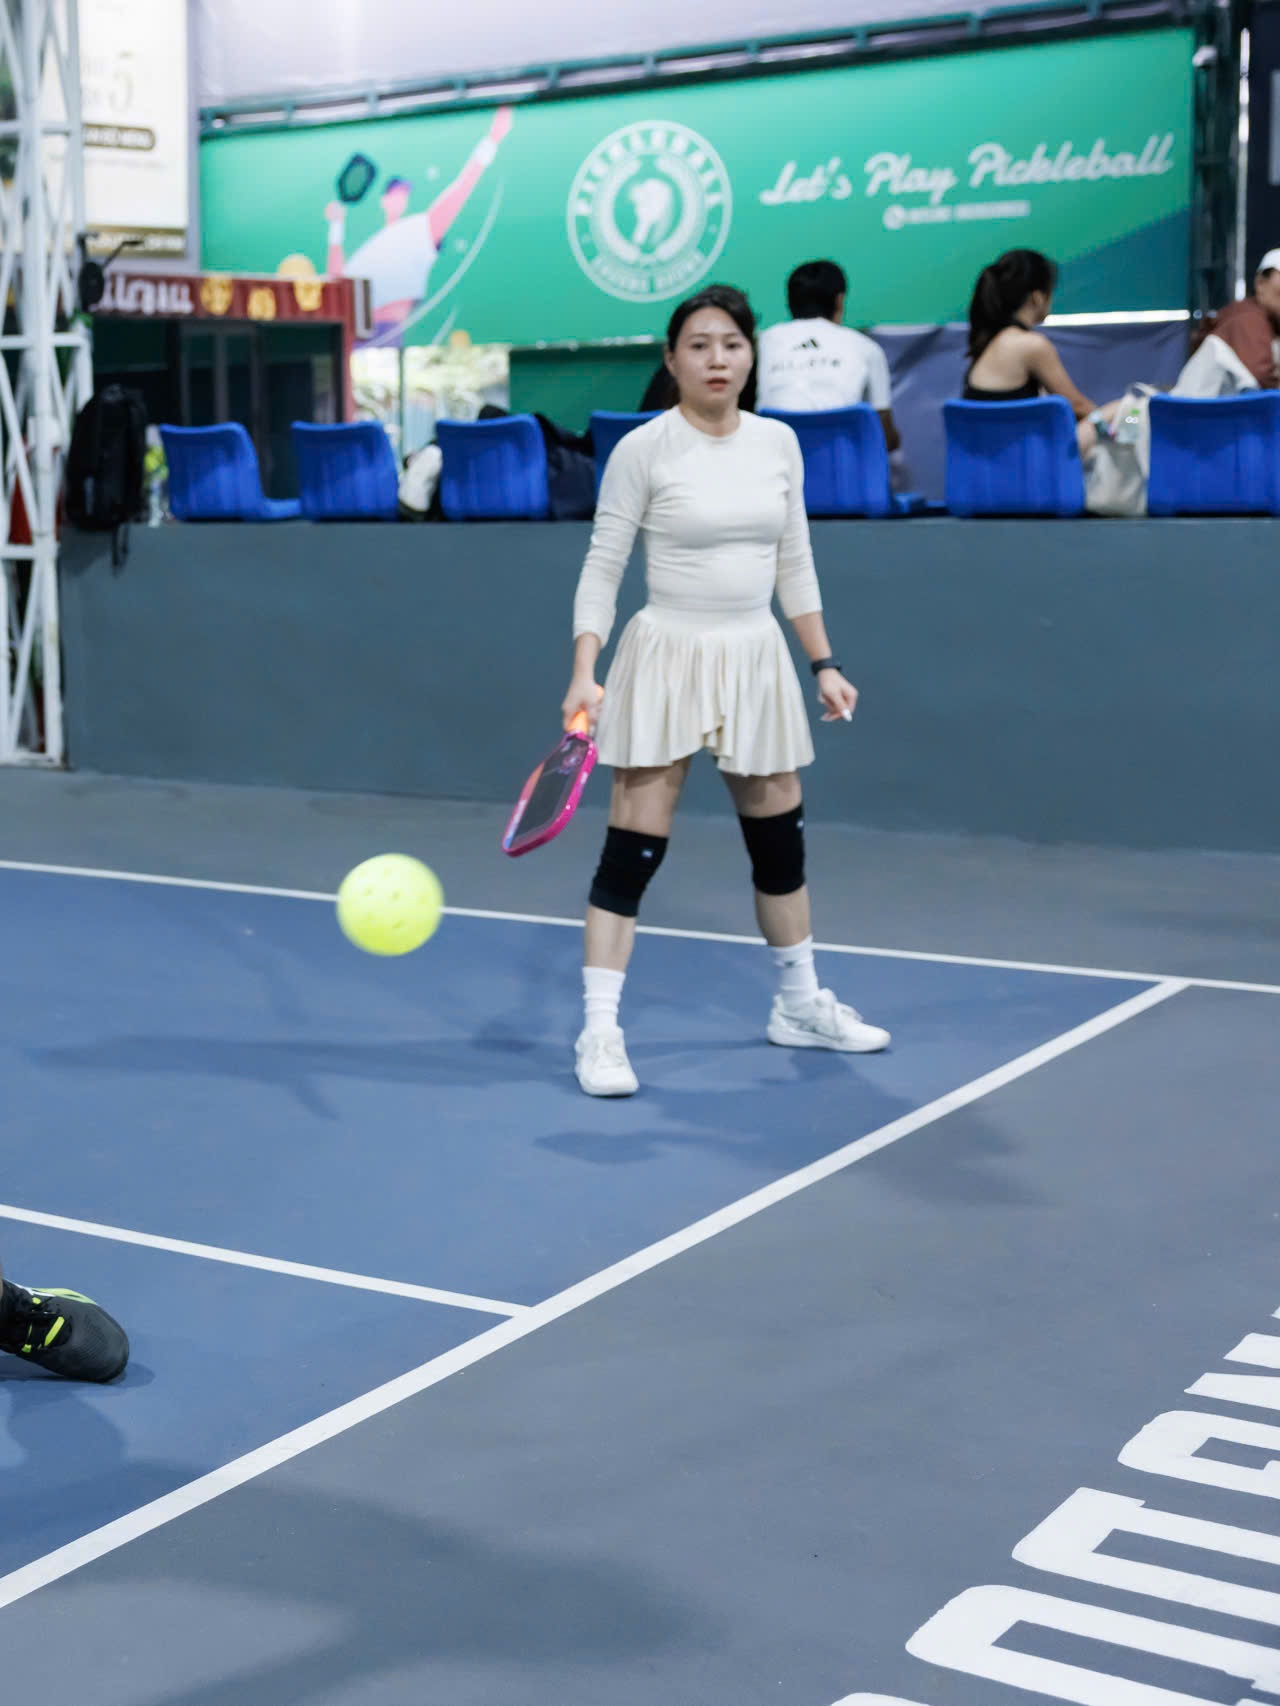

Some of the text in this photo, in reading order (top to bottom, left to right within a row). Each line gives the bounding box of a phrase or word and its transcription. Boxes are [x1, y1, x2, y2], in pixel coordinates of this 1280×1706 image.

[760, 133, 1174, 205] Let's Play Pickleball
